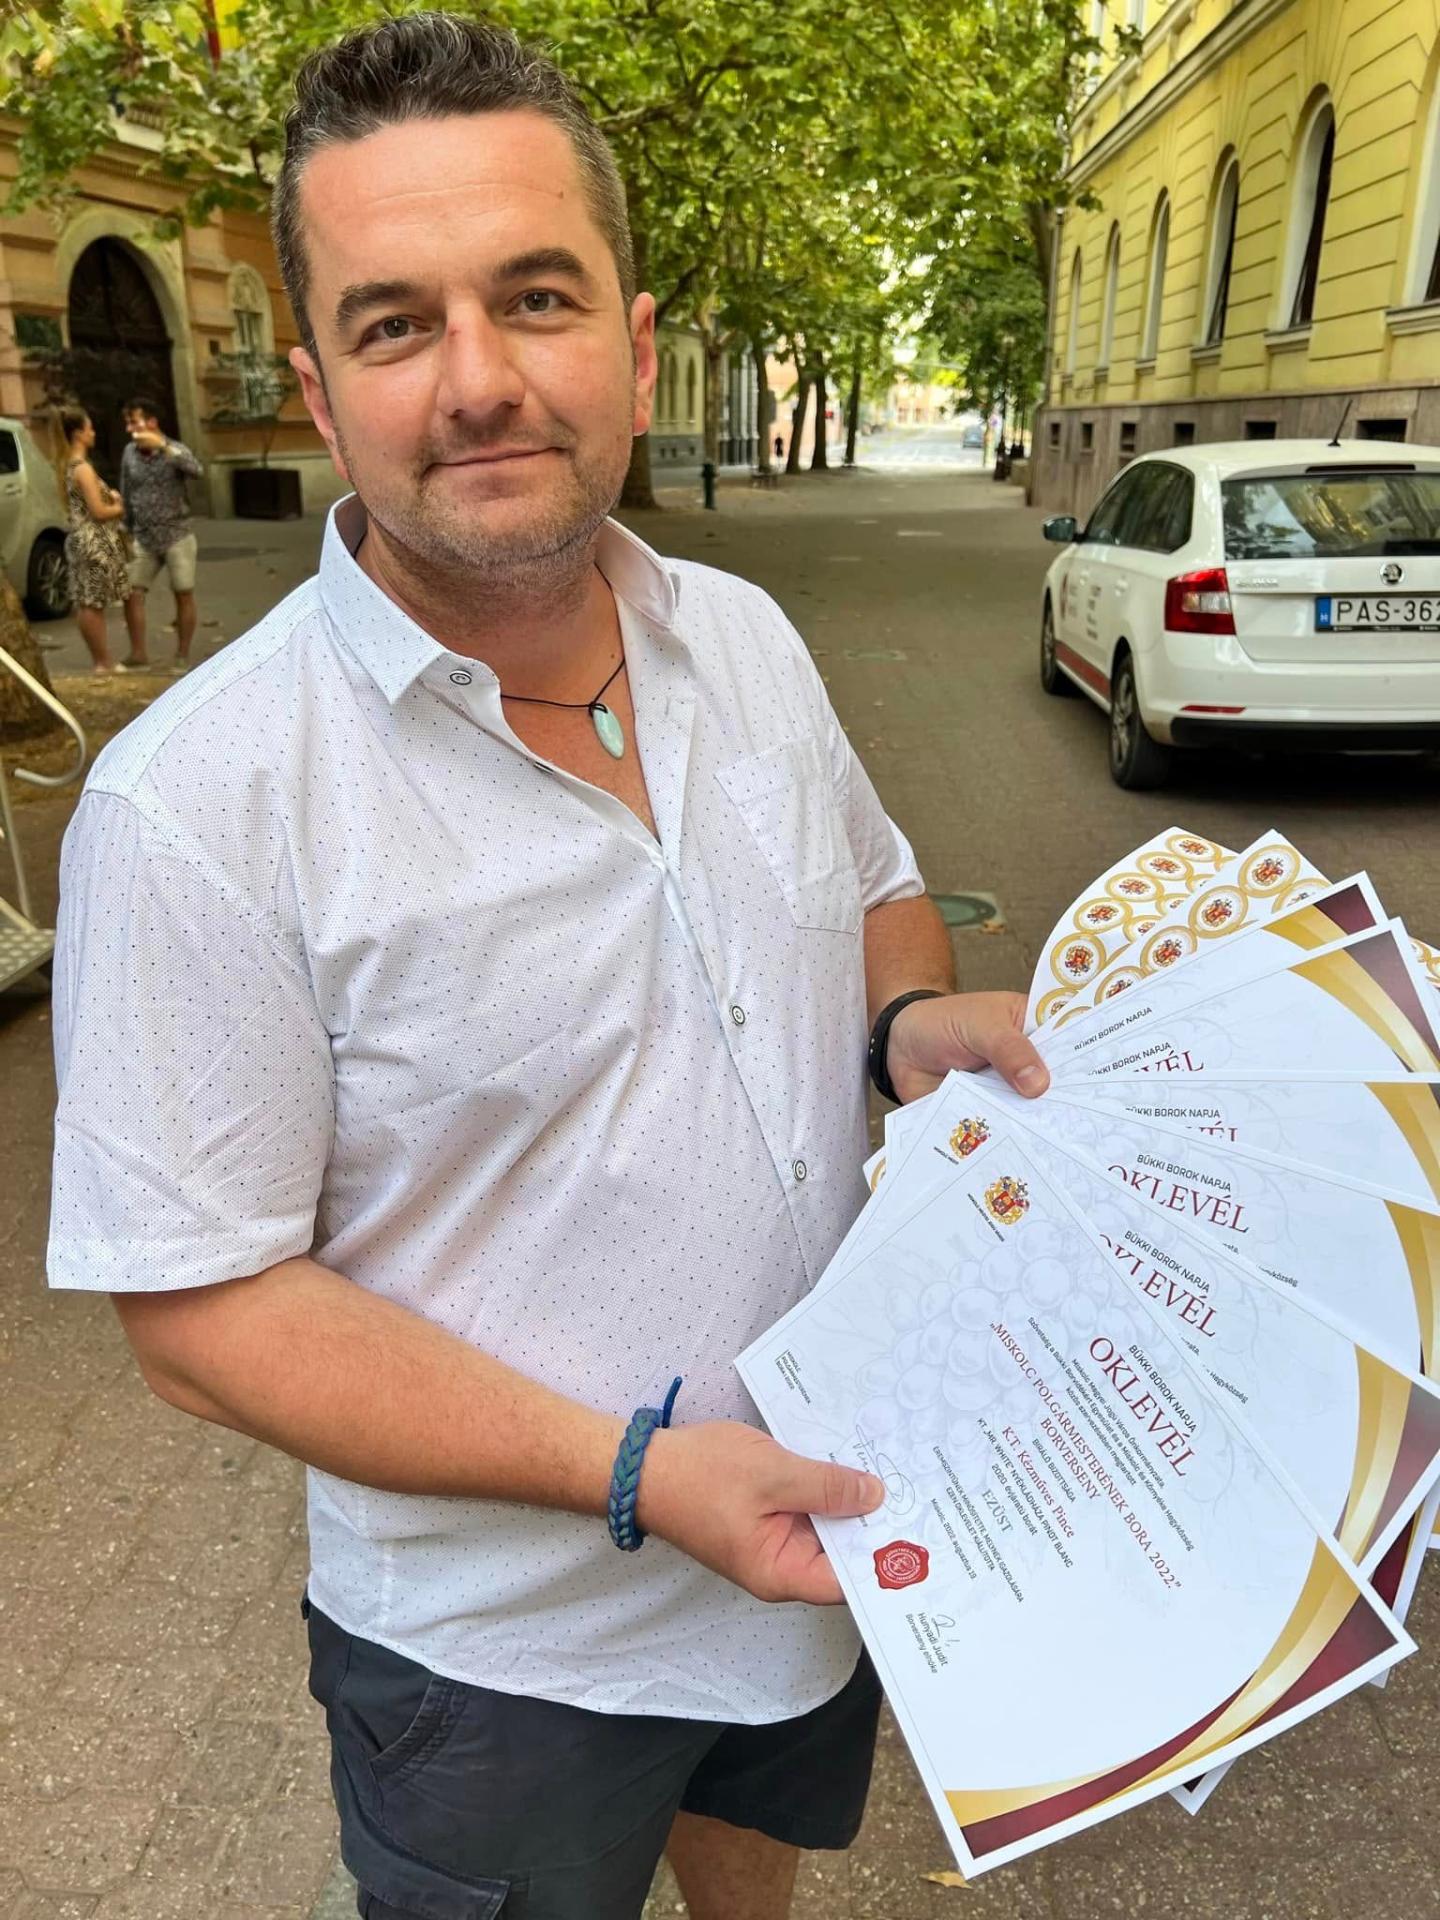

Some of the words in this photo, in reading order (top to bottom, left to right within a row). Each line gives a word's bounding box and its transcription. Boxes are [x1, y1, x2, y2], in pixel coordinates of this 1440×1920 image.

[1098, 1019, 1125, 1039] BOROK
[1126, 1007, 1152, 1025] NAPJA
[1087, 1066, 1111, 1076] KKI
[1112, 1053, 1142, 1070] BOROK
[1142, 1041, 1172, 1058] NAPJA
[1125, 1106, 1153, 1117] KKI
[1154, 1107, 1187, 1118] BOROK
[1188, 1108, 1221, 1118] NAPJA
[1136, 1154, 1165, 1170] BÜKKI
[1166, 1163, 1200, 1181] BOROK
[1200, 1174, 1232, 1192] NAPJA
[1124, 1230, 1150, 1253] BÜKKI
[1150, 1249, 1182, 1273] BOROK
[1181, 1269, 1210, 1293] NAPJA
[1070, 1357, 1091, 1383] Miskolc
[1087, 1380, 1107, 1405] Megyei
[1114, 1417, 1131, 1439] Város
[1089, 1337, 1192, 1476] OKLEVÉL
[1127, 1343, 1153, 1373] BÜKKI
[1148, 1370, 1176, 1404] BOROK
[1171, 1401, 1197, 1433] NAPJA
[989, 1322, 1037, 1379] „MISKOLC
[1032, 1378, 1127, 1511] POLGÁRMESTERÉNEK
[1122, 1511, 1152, 1552] BORA
[1040, 1417, 1100, 1499] BORVERSENY
[1064, 1366, 1093, 1404] Borvidékért
[1089, 1401, 1114, 1434] Egyesület
[1110, 1432, 1120, 1443] és
[1120, 1445, 1141, 1472] Miskolc
[1136, 1470, 1147, 1481] és
[1163, 1509, 1194, 1552] Hegyközség
[1002, 1425, 1021, 1450] K.T.
[1016, 1449, 1054, 1506] Kézműves
[1051, 1504, 1074, 1538] Pince
[1047, 1461, 1076, 1503] BIZOTTSÁGA
[1109, 1449, 1137, 1486] megtartott
[944, 1485, 959, 1504] EZEN
[953, 1501, 977, 1536] OKLEVELET
[980, 1488, 1013, 1532] EZÜST
[1003, 1484, 1026, 1516] évjáratú
[1021, 1513, 1038, 1536] borát
[1010, 1468, 1044, 1521] NYÉKLÁDHÁZA
[1040, 1518, 1059, 1542] PINOT
[1053, 1540, 1074, 1568] BLANC
[951, 1539, 972, 1572] augusztus
[982, 1532, 1002, 1563] MELYNEK
[997, 1560, 1024, 1603] IGAZOLÁSÁRA
[916, 1611, 938, 1645] Hunyadi
[931, 1644, 949, 1667] Judit
